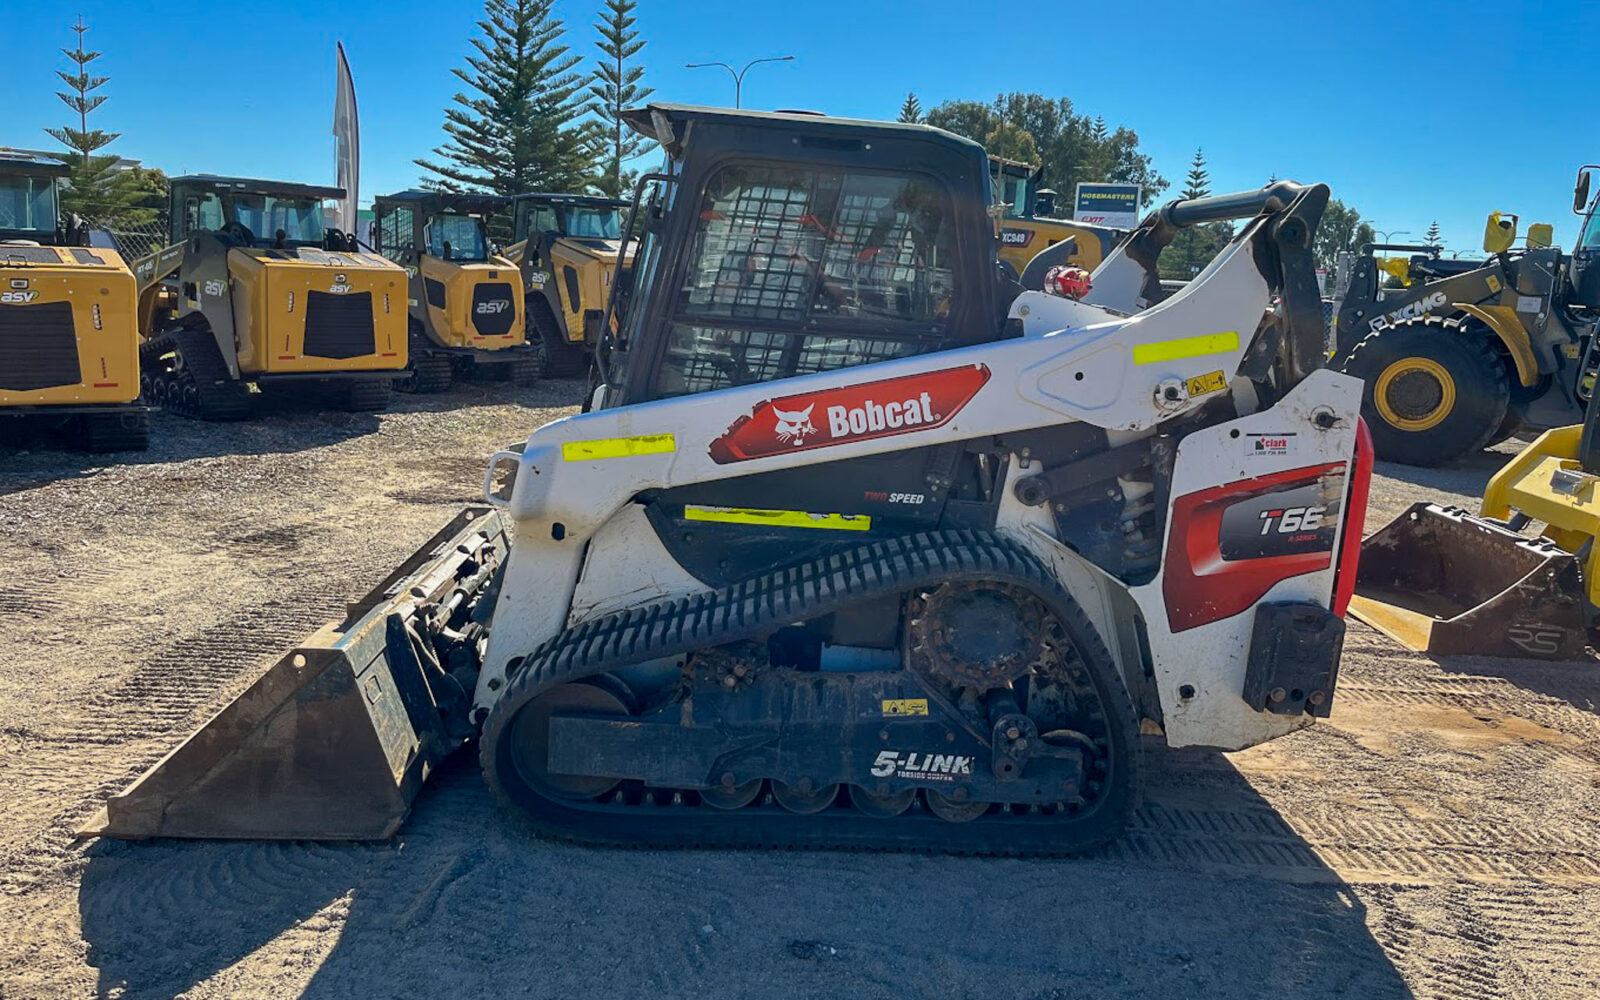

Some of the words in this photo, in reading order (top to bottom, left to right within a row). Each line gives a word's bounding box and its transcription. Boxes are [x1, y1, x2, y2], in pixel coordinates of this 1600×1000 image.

[1081, 192, 1136, 200] HOSEMASTERS
[1390, 291, 1447, 320] XCMG
[827, 392, 934, 438] Bobcat
[888, 493, 925, 504] SPEED
[1260, 507, 1327, 536] T66
[870, 750, 970, 777] 5-LINK
